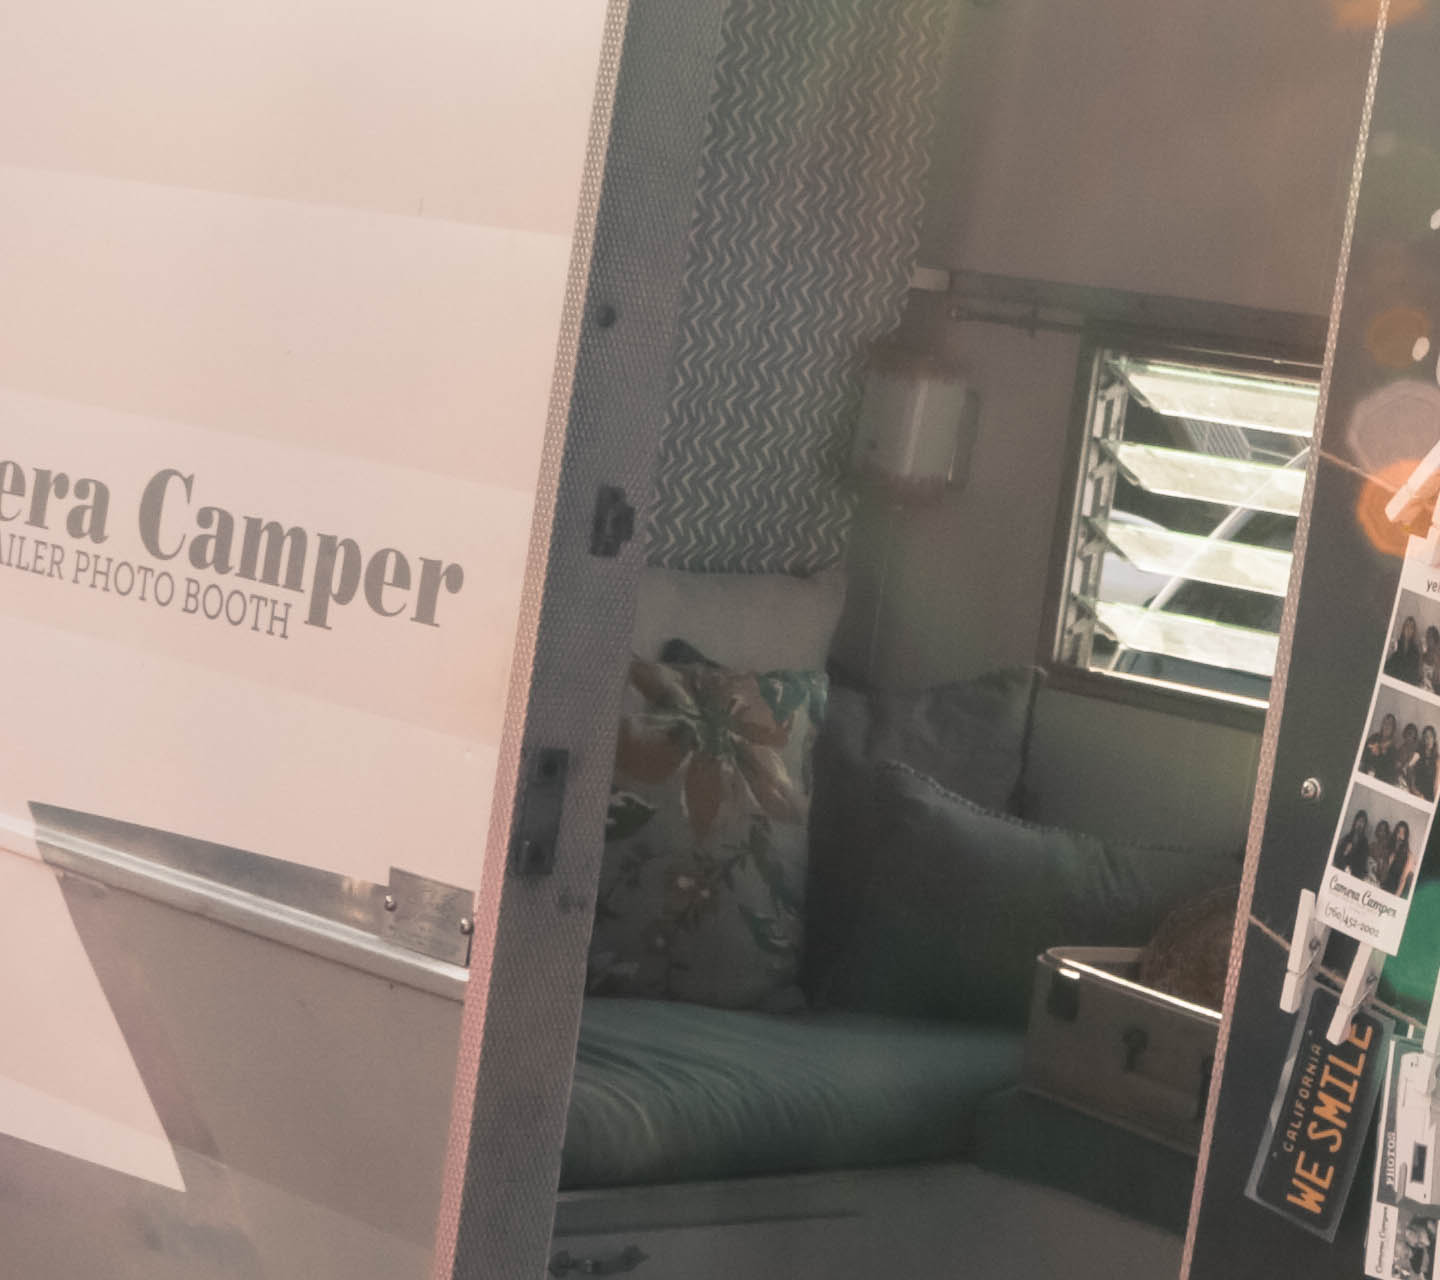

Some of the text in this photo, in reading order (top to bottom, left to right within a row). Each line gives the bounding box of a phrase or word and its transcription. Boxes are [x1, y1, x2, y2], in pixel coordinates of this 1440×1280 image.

[71, 549, 176, 609] PHOTO
[180, 577, 294, 640] BOOTH
[137, 468, 465, 631] Camper
[1329, 874, 1398, 918] Camera Camper
[1282, 1043, 1323, 1153] CALIFORNIA
[1286, 1024, 1374, 1215] WE SMILE
